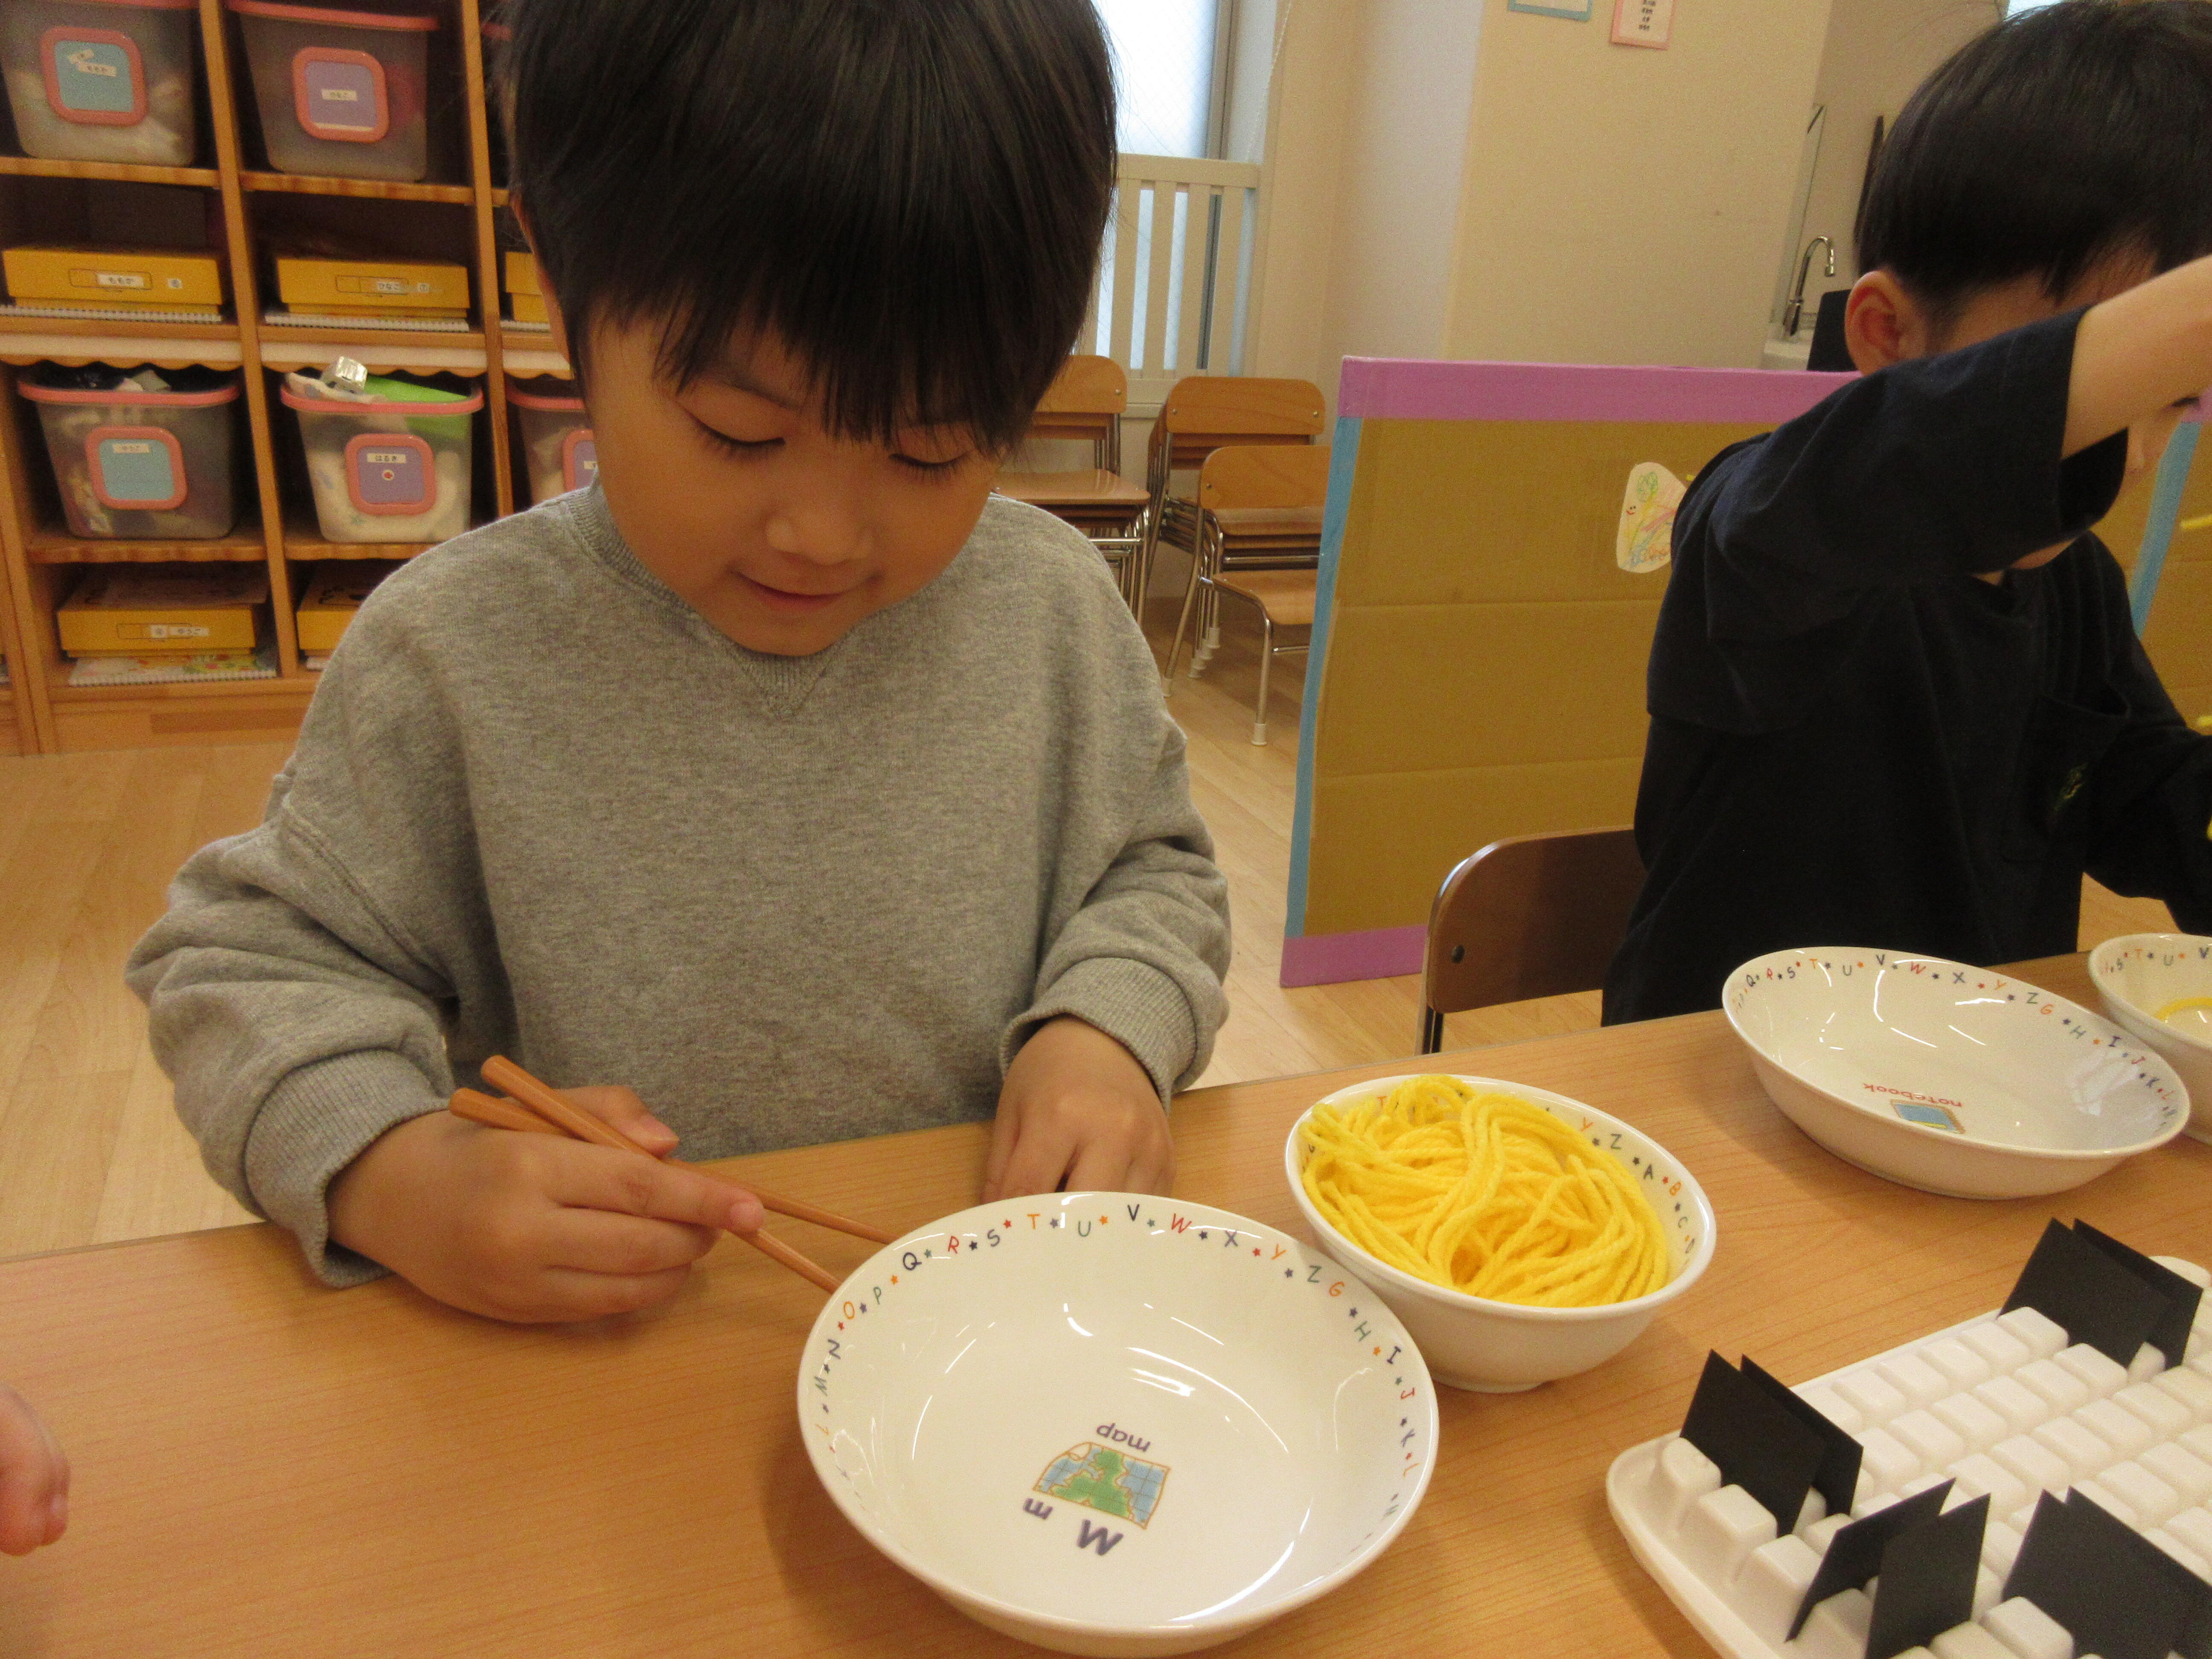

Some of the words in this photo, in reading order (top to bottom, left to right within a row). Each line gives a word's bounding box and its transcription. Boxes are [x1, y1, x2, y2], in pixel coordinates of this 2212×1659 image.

[1787, 966, 1796, 979] S
[1809, 958, 1818, 969] T
[1842, 965, 1852, 976] U
[1876, 954, 1885, 966] V
[1910, 961, 1927, 975] W
[1952, 972, 1966, 984] X
[2026, 992, 2039, 1004] Z
[1863, 1083, 1962, 1107] notebook
[1610, 1133, 1622, 1149] Z
[1643, 1164, 1653, 1180] A
[873, 1286, 882, 1305] P
[902, 1252, 923, 1271] Q
[948, 1236, 960, 1254] R
[987, 1229, 1001, 1247] S
[1027, 1214, 1041, 1229] T
[1077, 1221, 1091, 1237] U
[1127, 1204, 1140, 1221] V
[1171, 1213, 1192, 1234] W
[1224, 1229, 1238, 1247] X
[1271, 1243, 1286, 1260] Y
[1307, 1265, 1322, 1283] Z
[1328, 1281, 1345, 1297] G
[1353, 1321, 1372, 1342] H
[1095, 1422, 1152, 1452] map
